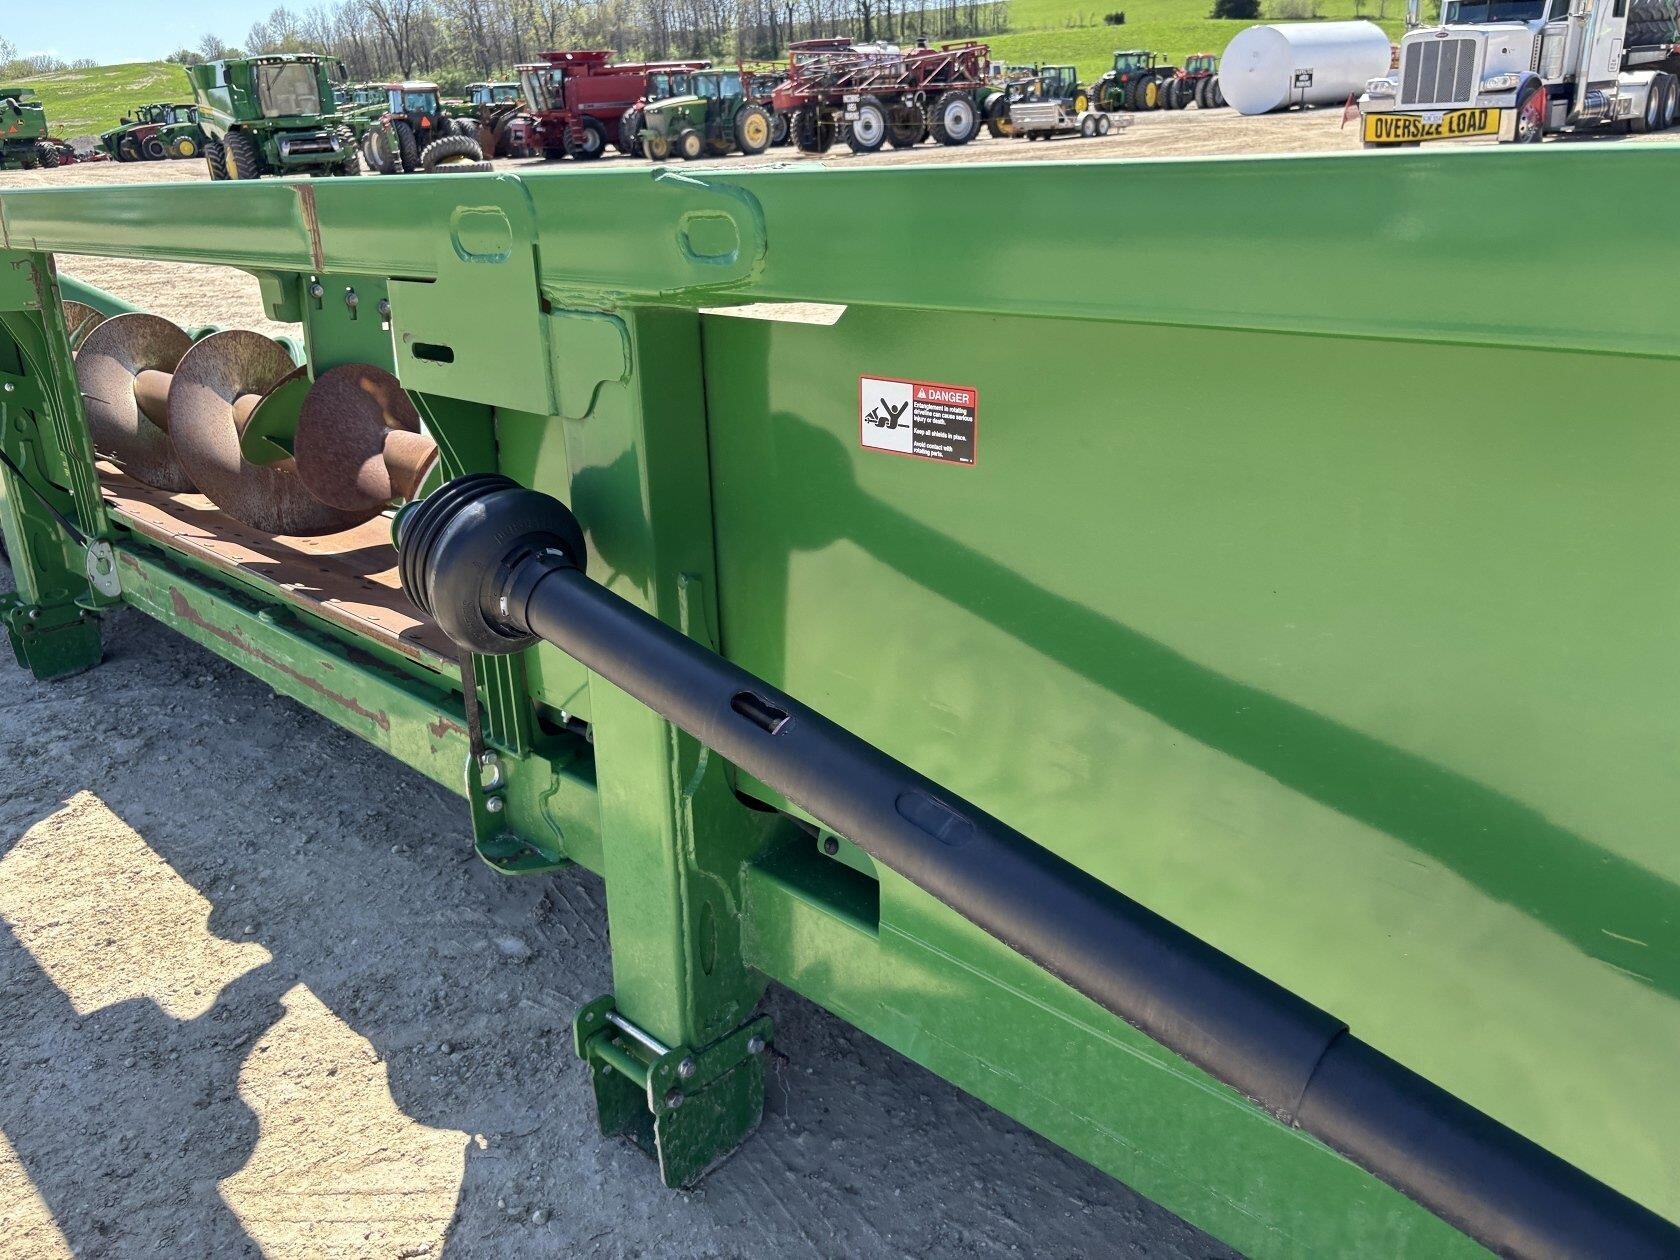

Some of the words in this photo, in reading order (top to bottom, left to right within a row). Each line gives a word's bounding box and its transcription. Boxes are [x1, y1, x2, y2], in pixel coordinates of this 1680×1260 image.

[1375, 118, 1442, 138] OVERSIZE
[1448, 110, 1487, 133] LOAD
[928, 390, 969, 404] DANGER
[914, 402, 943, 411] Entanglement
[914, 448, 930, 456] rotating
